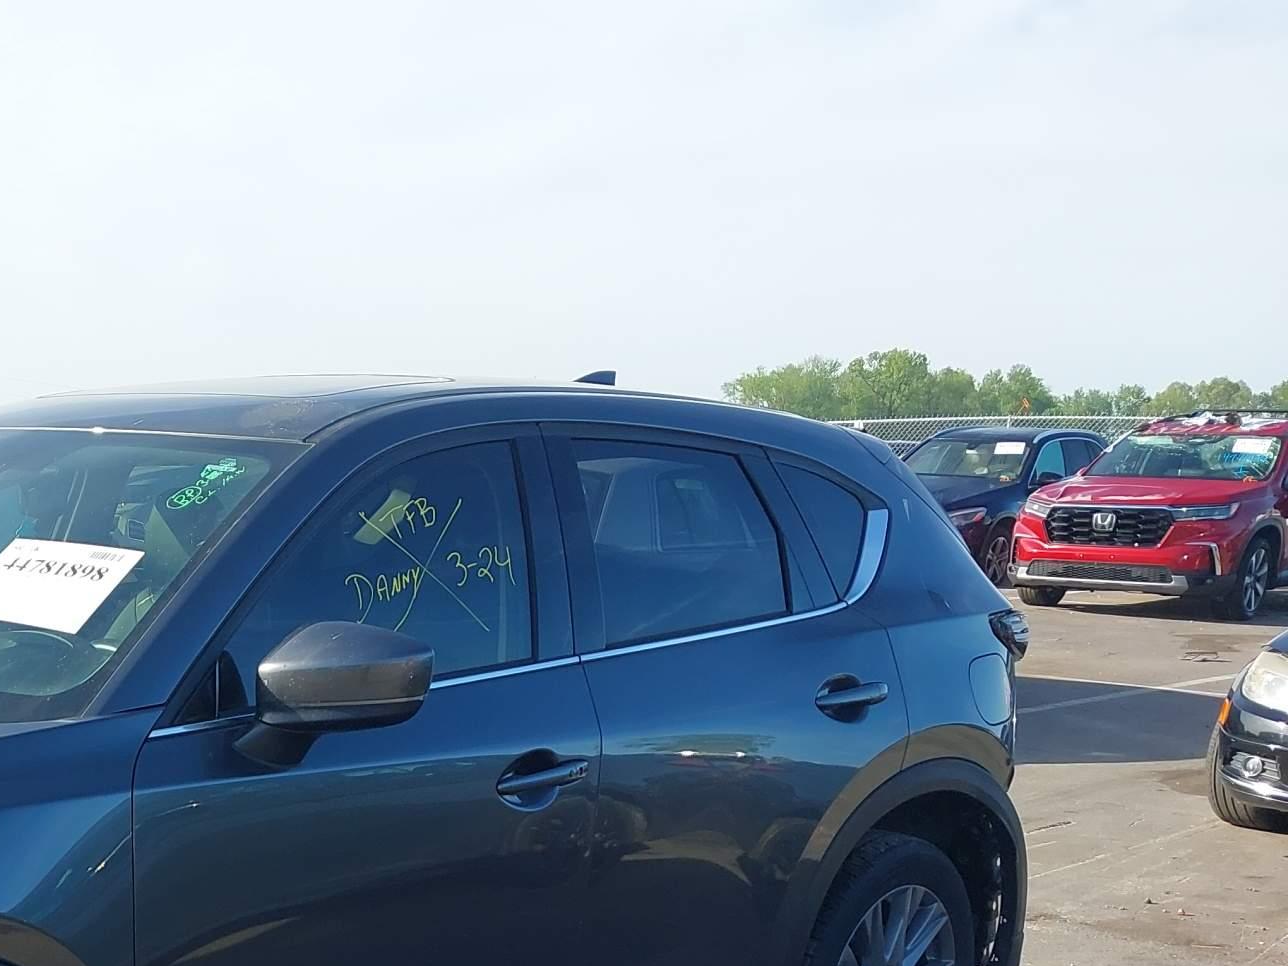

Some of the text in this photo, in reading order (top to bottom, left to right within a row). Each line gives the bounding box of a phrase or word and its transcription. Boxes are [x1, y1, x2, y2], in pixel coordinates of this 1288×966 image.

[2, 556, 110, 582] 44781898
[446, 545, 517, 588] 3-24
[344, 565, 421, 625] DANNY
